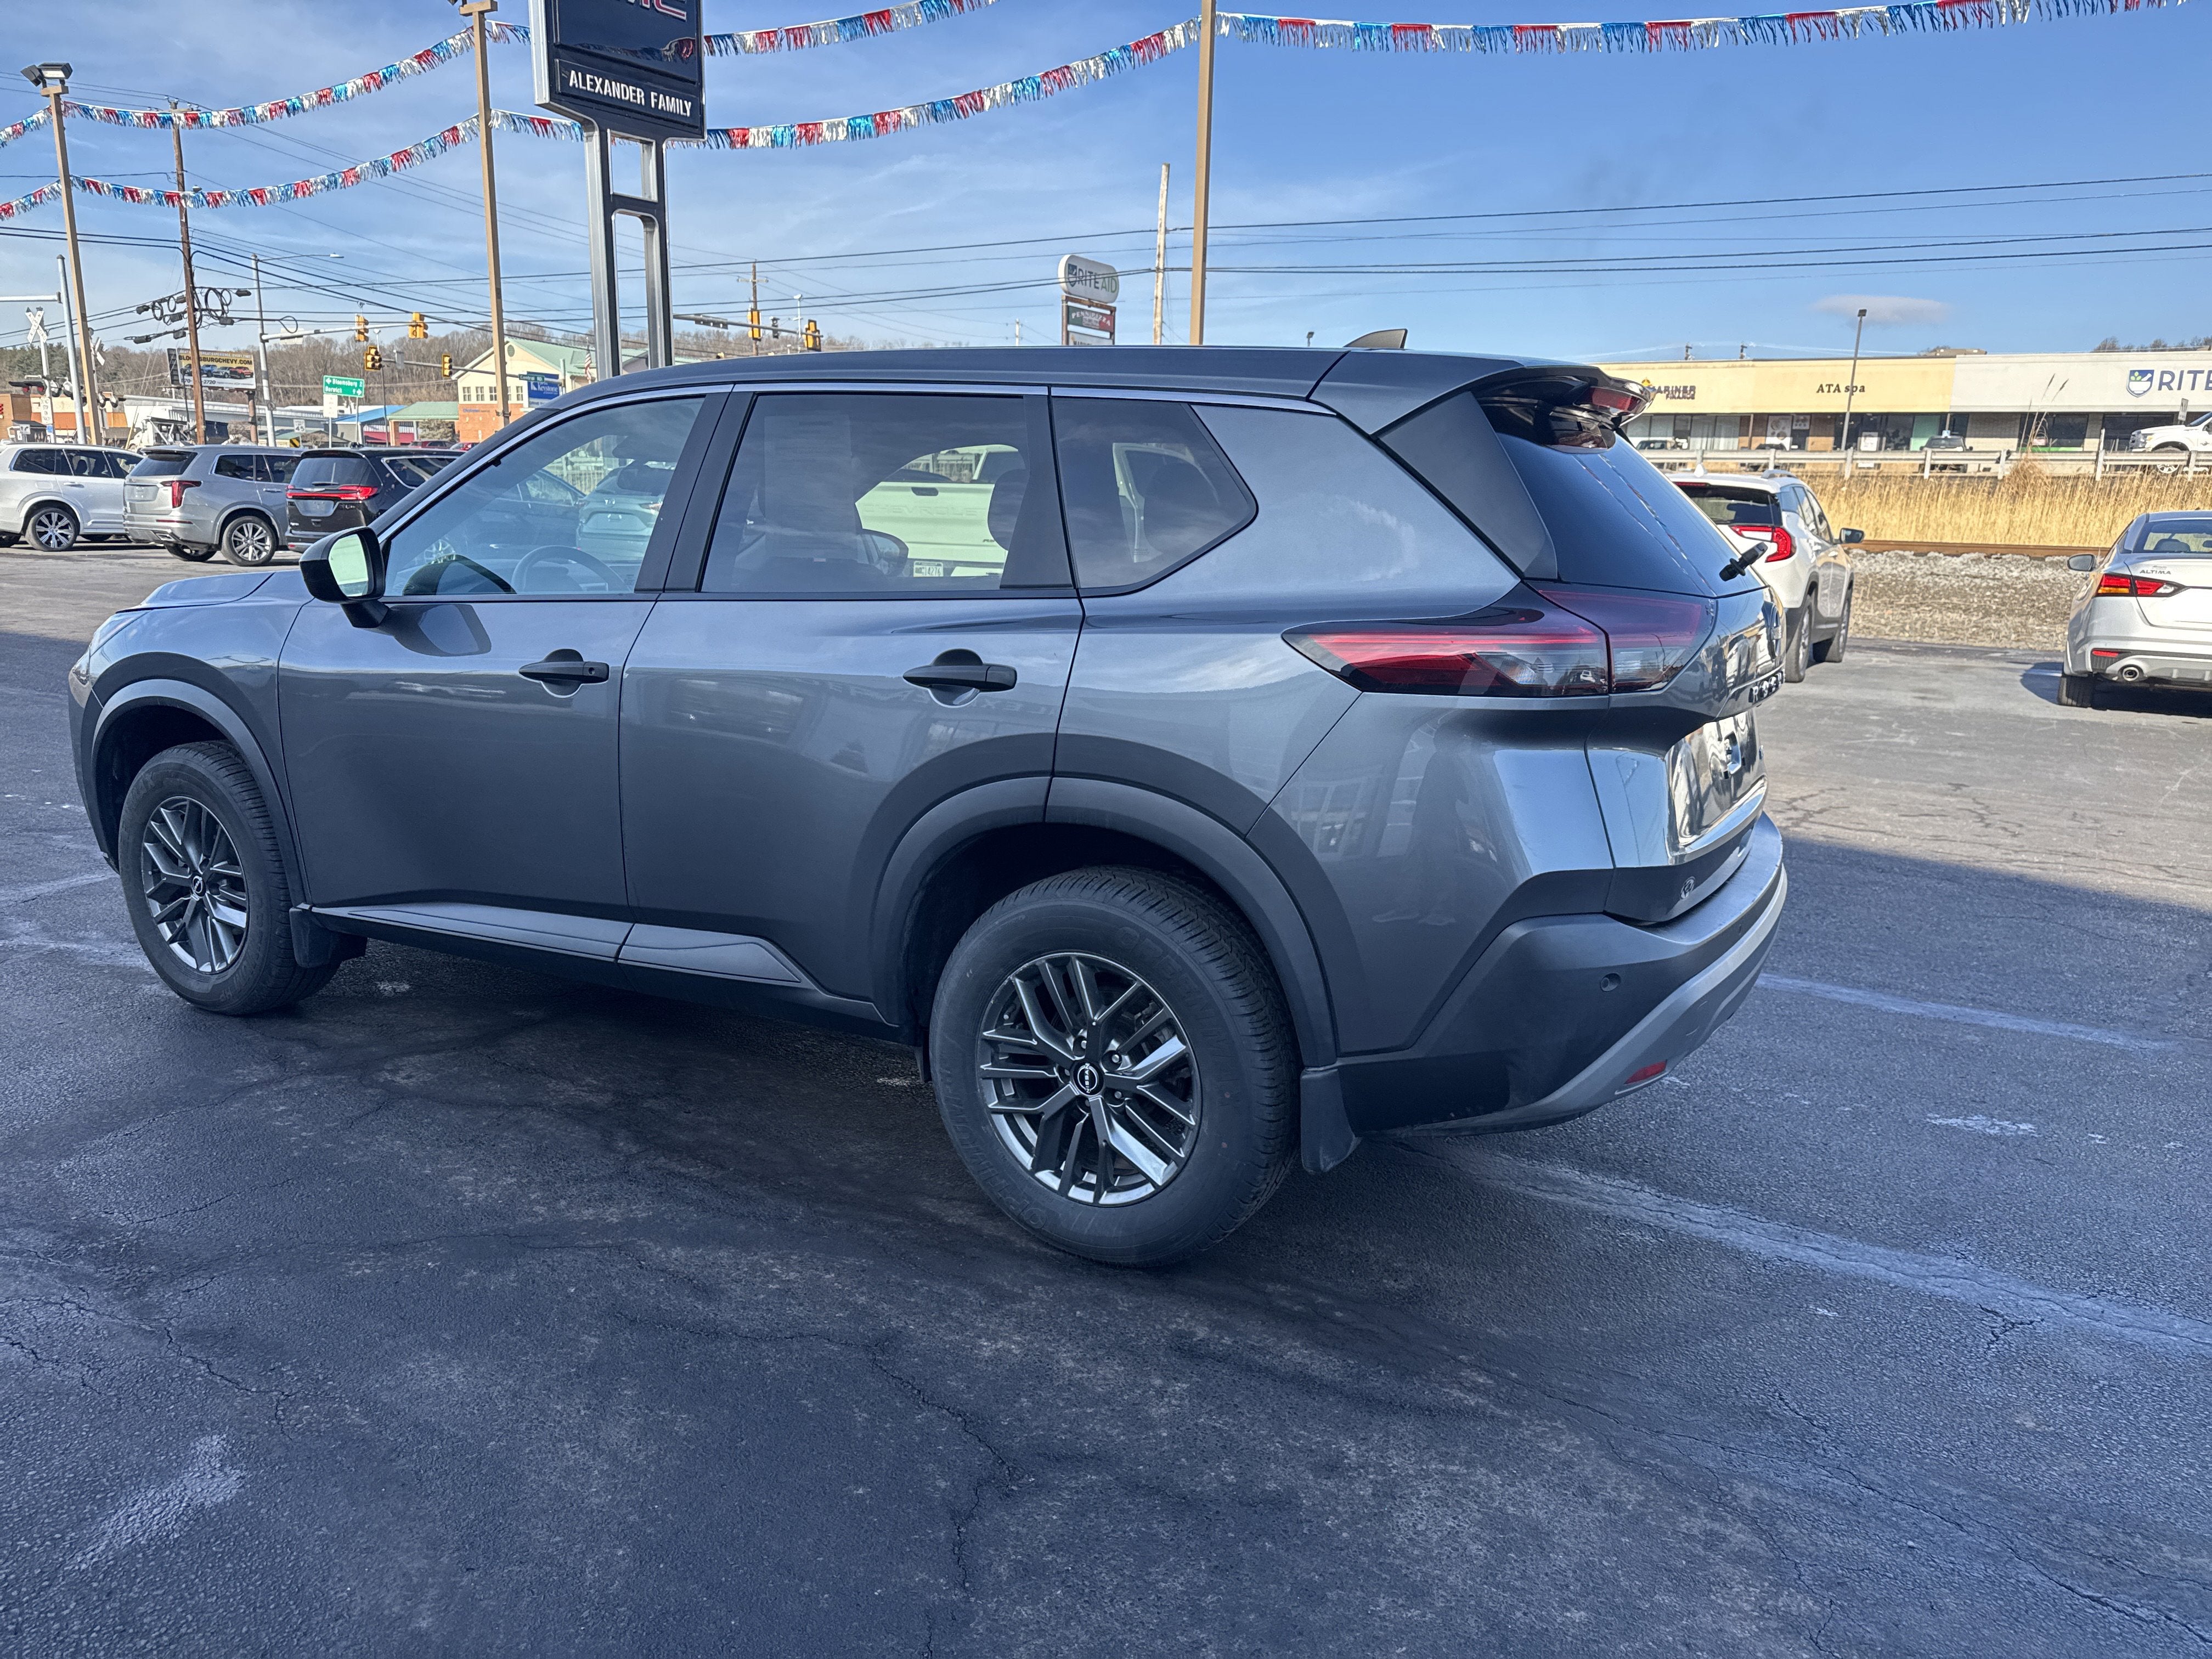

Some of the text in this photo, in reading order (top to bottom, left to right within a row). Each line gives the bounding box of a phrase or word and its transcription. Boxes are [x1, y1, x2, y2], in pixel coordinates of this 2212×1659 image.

[569, 70, 692, 117] ALEXANDER FAMILY
[1078, 268, 1118, 294] RITE AID
[1071, 311, 1090, 319] PENN
[1091, 312, 1110, 326] PIZZA
[178, 355, 253, 365] BLOSBURGCHEVY.COM
[332, 378, 358, 387] Bloomsburg
[1656, 385, 1696, 394] ARINER
[1816, 383, 1865, 396] ATA spa
[1749, 668, 1785, 704] ROGU
